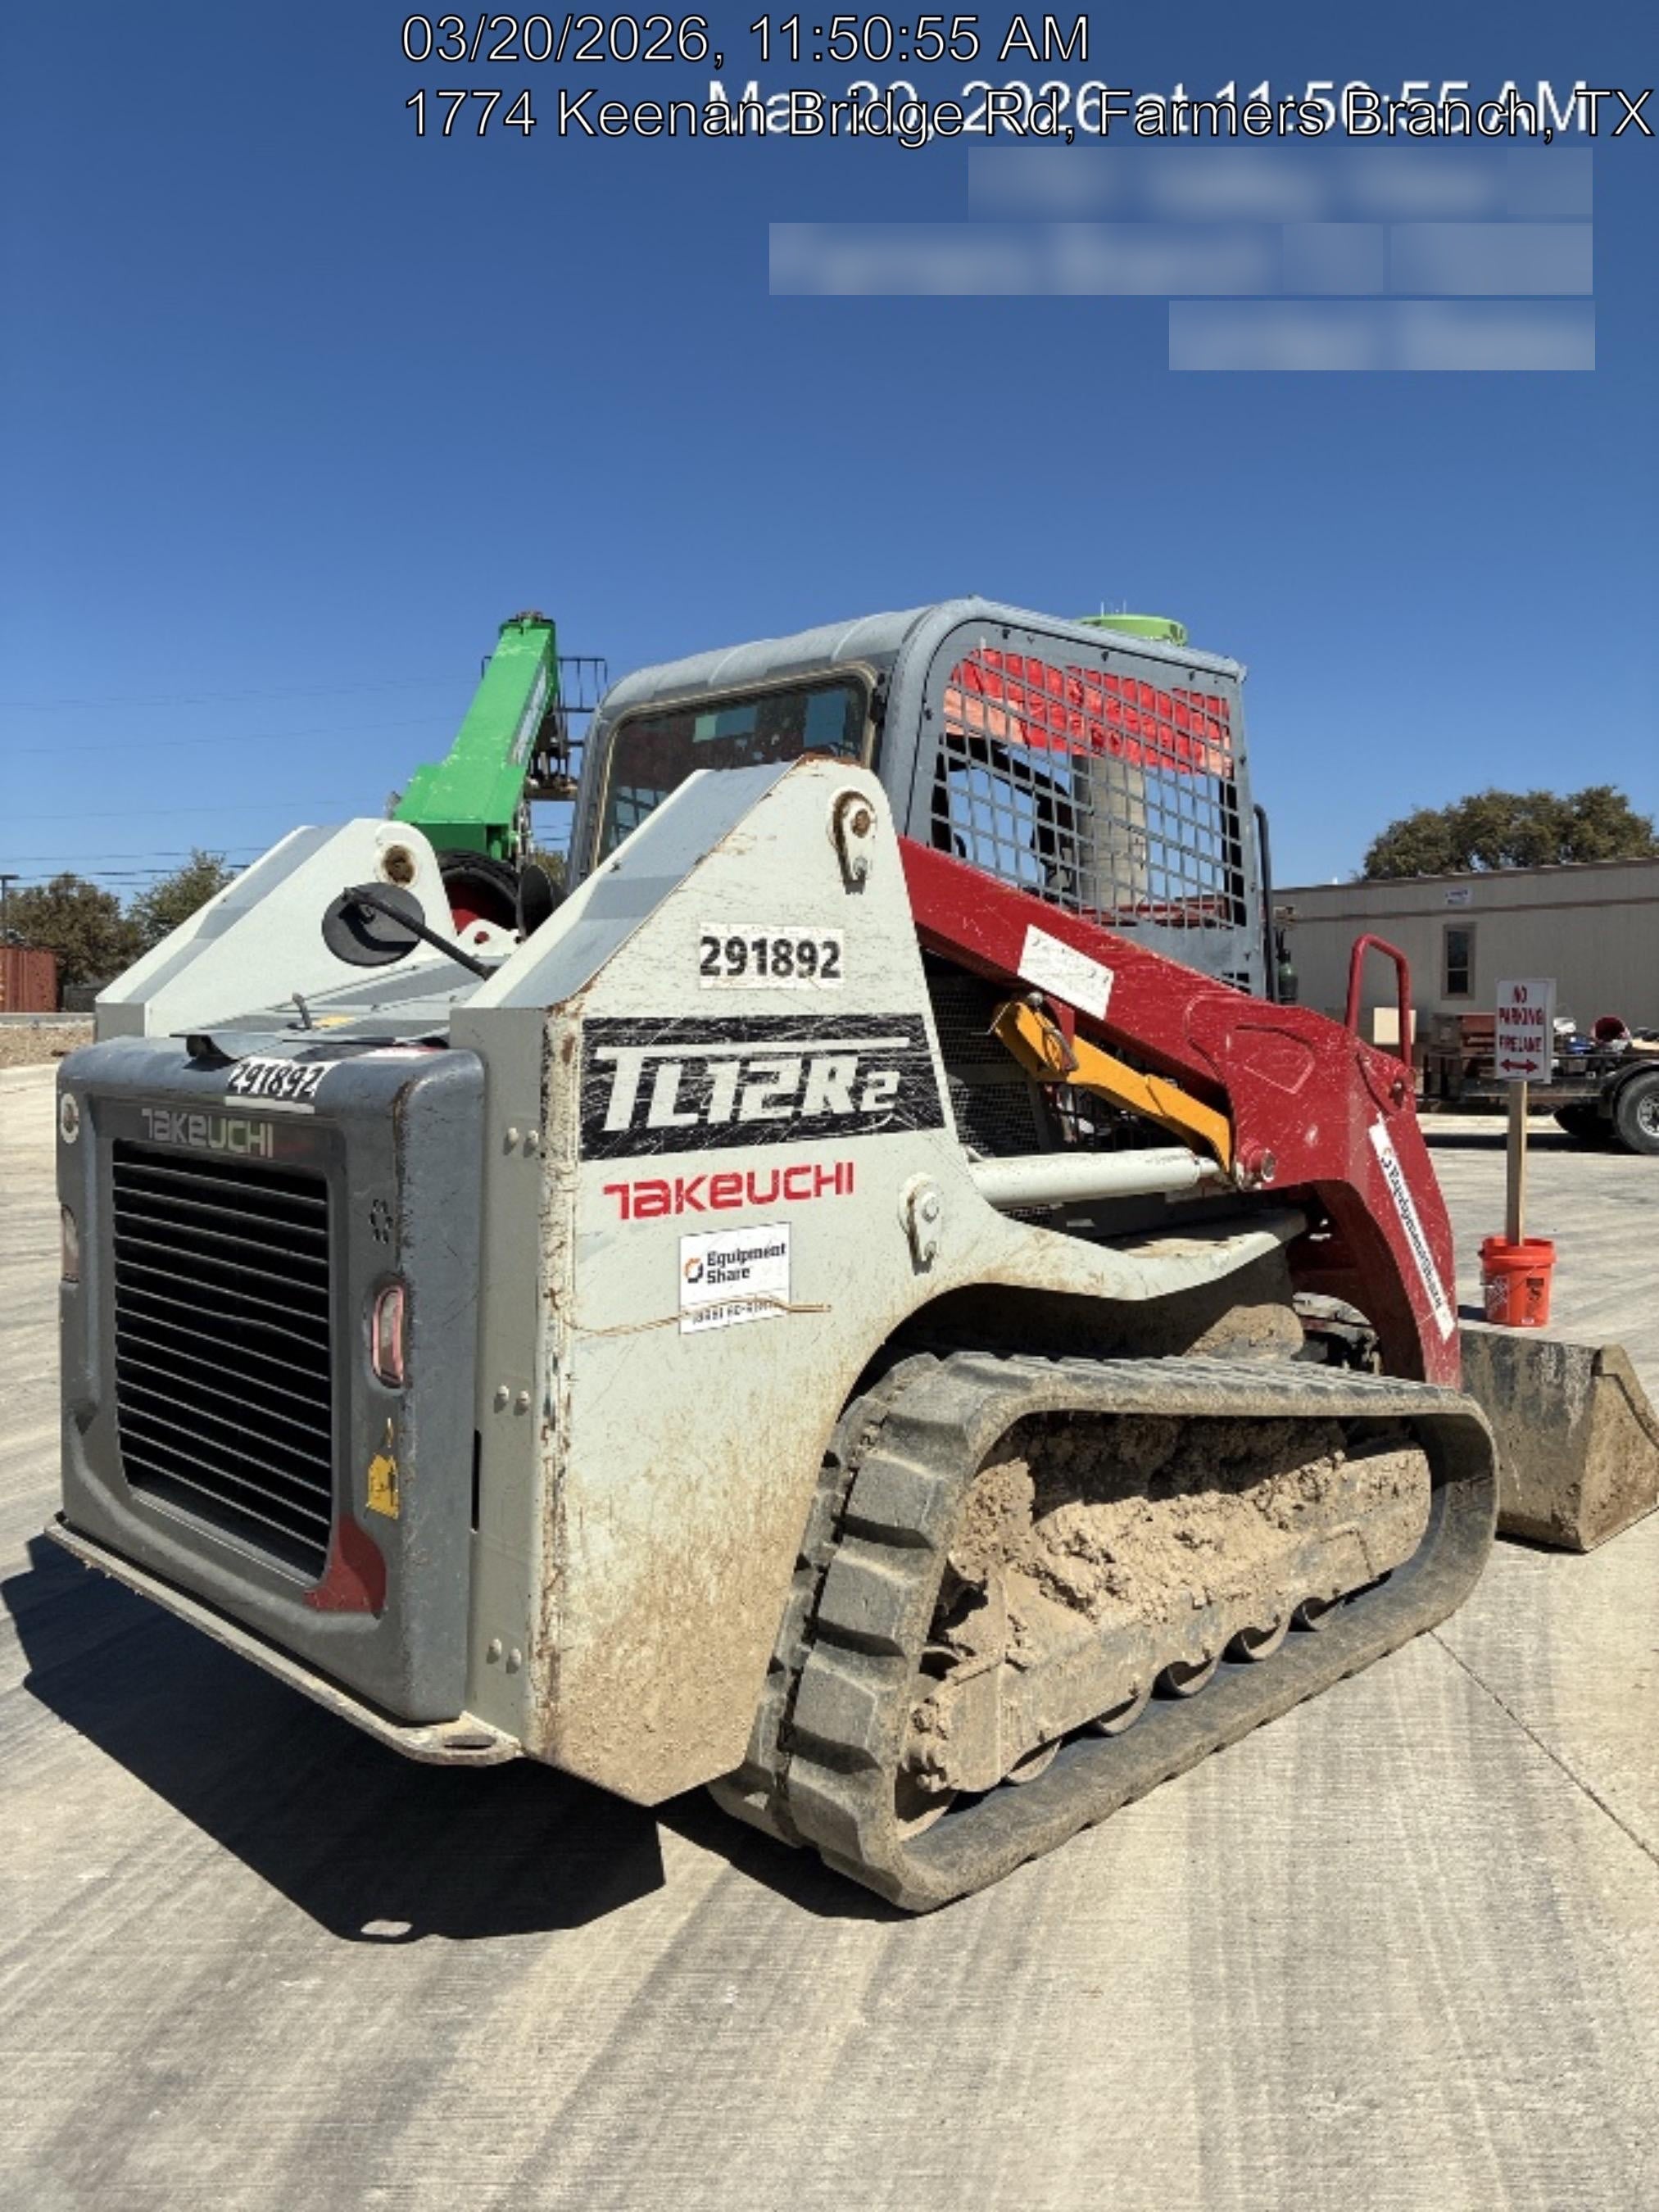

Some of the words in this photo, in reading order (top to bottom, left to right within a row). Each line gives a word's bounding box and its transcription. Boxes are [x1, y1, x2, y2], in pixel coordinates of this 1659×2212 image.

[699, 936, 841, 979] 291892
[1512, 985, 1528, 1004] NO
[1498, 1007, 1544, 1026] PARKING
[228, 1063, 326, 1099] 291892
[595, 1036, 910, 1133] TL12R2
[141, 1108, 274, 1159] TAKEUCHI
[603, 1162, 854, 1221] TAKEUCHI
[707, 1242, 786, 1268] Equipment
[707, 1267, 750, 1284] Share
